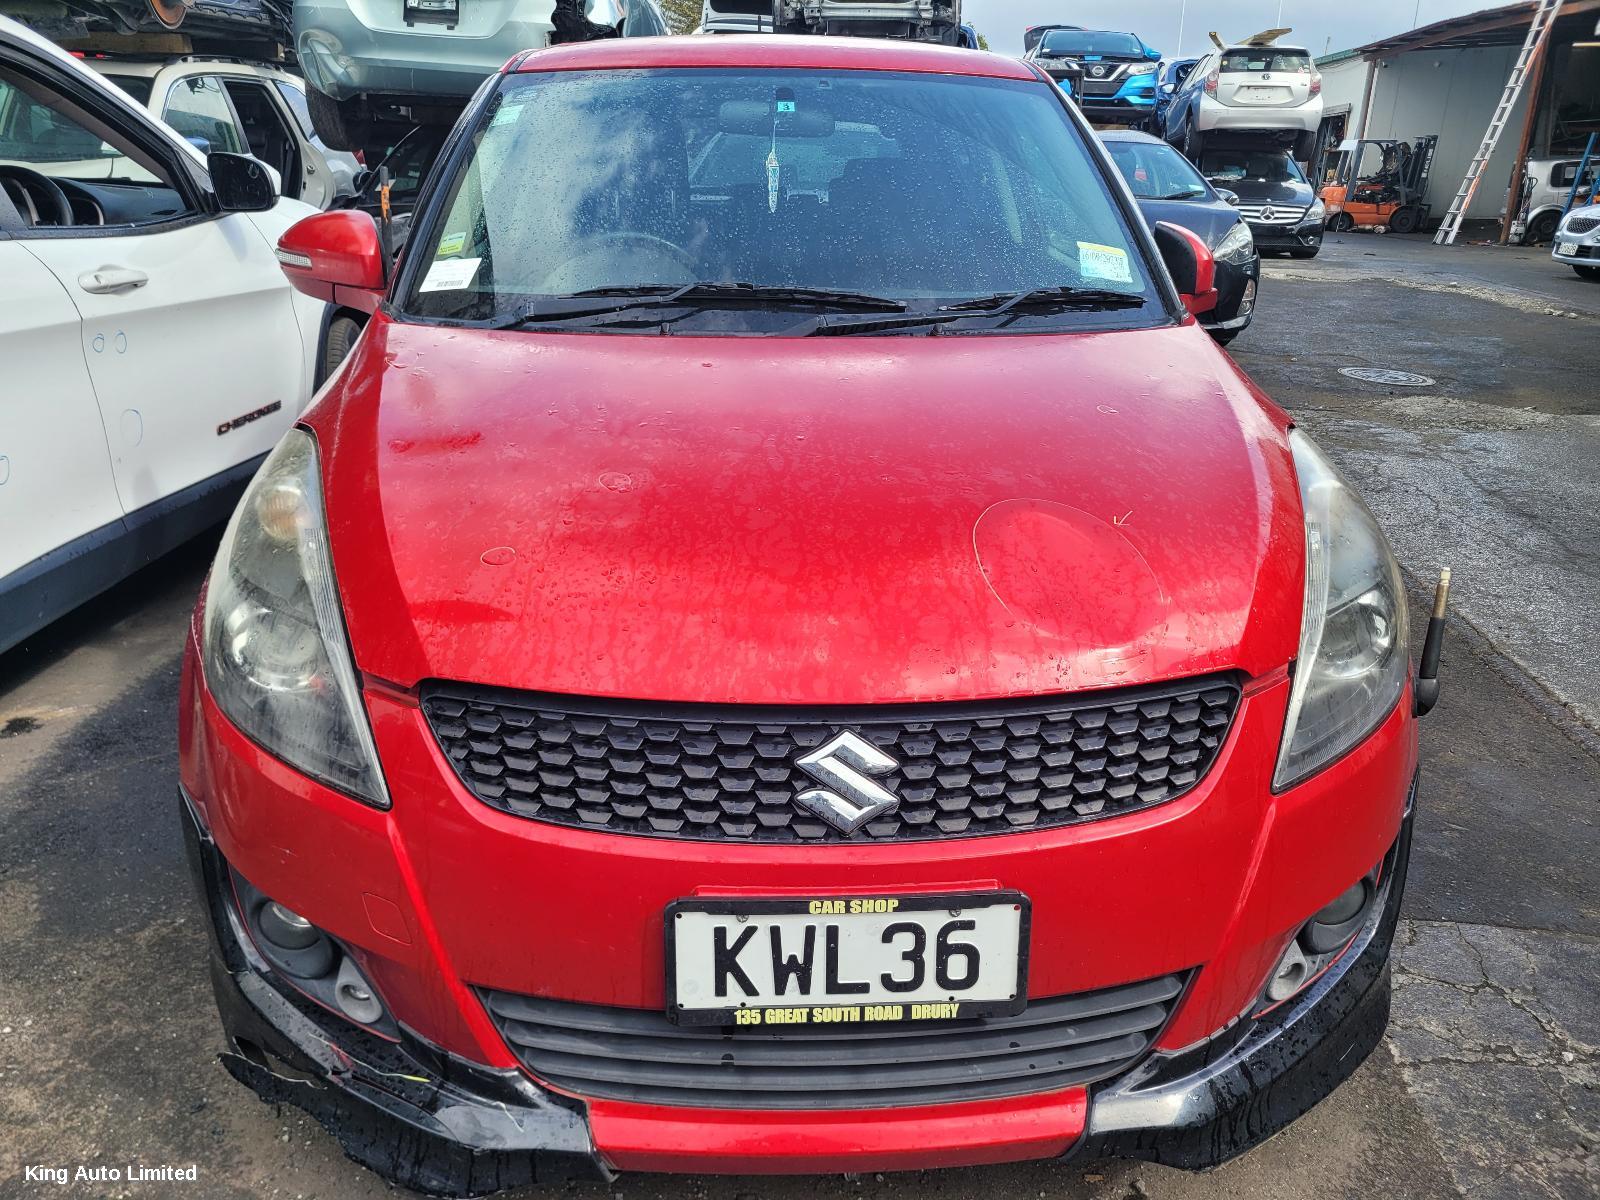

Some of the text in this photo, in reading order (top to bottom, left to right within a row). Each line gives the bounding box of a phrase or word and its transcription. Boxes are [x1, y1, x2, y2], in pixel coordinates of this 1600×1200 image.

[217, 400, 281, 436] CHEROKEE
[809, 898, 898, 914] CAR SHOP
[714, 919, 980, 997] KWL36
[735, 1003, 960, 1025] 135 GREAT SOUTH ROAD DRURY
